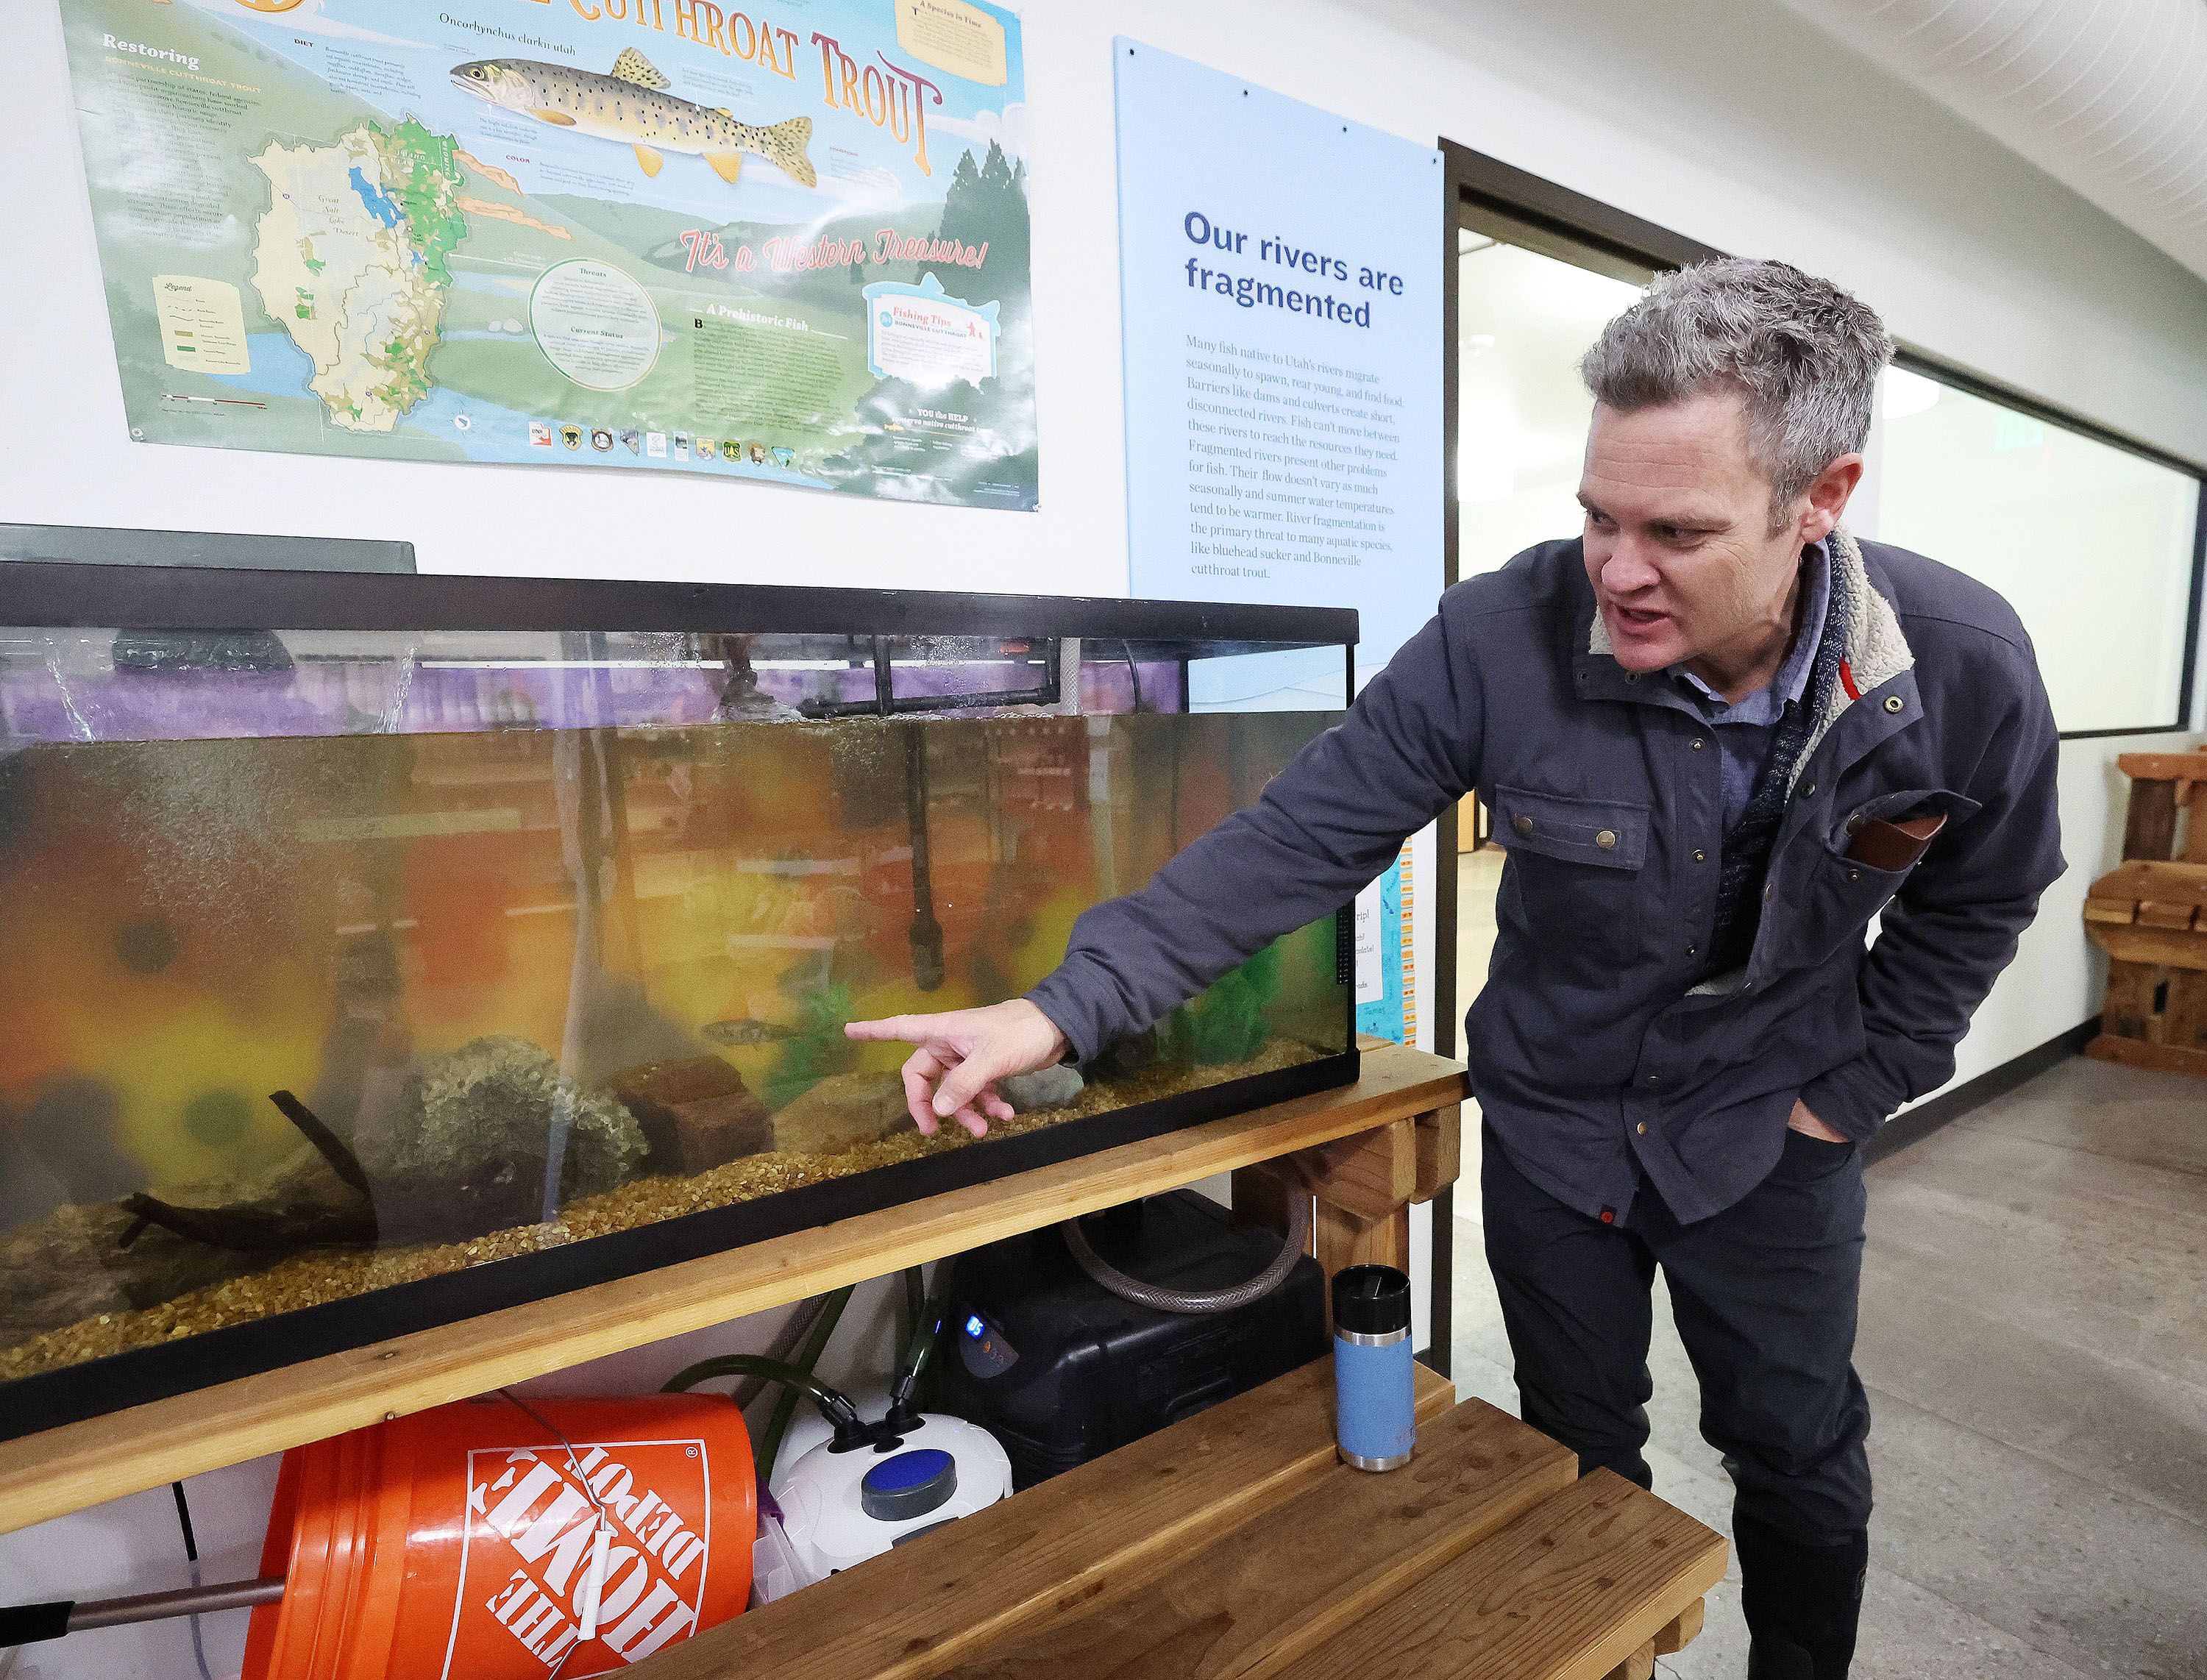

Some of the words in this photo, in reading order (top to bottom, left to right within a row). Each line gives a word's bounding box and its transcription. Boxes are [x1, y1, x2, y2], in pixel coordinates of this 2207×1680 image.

[927, 3, 954, 18] Species
[964, 16, 982, 28] Time
[294, 38, 314, 48] DIET
[439, 12, 515, 40] Oncorhynchus
[553, 44, 575, 56] utah
[102, 33, 200, 71] Restoring
[168, 70, 227, 87] CUTTHROAT
[230, 82, 262, 94] TROUT
[811, 31, 943, 177] TROUT
[505, 154, 531, 164] COLOR
[680, 229, 730, 273] It's
[735, 245, 756, 271] a
[762, 234, 867, 273] Western
[873, 228, 989, 271] Treasure!
[1184, 210, 1248, 255] Our
[1259, 235, 1349, 282] rivers
[1359, 266, 1404, 296] are
[164, 282, 193, 293] Legend
[579, 267, 607, 277] Threats
[1185, 257, 1371, 330] fragmented
[570, 327, 599, 336] Current
[706, 303, 717, 316] A
[718, 305, 784, 327] Prehistoric
[785, 317, 809, 332] Fish
[893, 306, 929, 326] Fishing
[931, 313, 951, 328] Tips
[895, 321, 931, 332] BONNEVILLE
[1187, 335, 1216, 353] Many
[1219, 341, 1237, 355] fish
[1240, 349, 1270, 360] native
[1273, 354, 1282, 364] to
[1285, 355, 1315, 370] Utah's
[1318, 364, 1343, 376] rivers
[1346, 370, 1379, 383] migrate
[1186, 360, 1240, 378] seasonally
[1243, 368, 1252, 378] to
[1255, 373, 1289, 387] spawn,
[1292, 379, 1310, 389] rear
[1314, 383, 1343, 397] young,
[1346, 388, 1362, 399] and
[1365, 390, 1381, 402] find
[1384, 394, 1403, 407] food.
[917, 408, 934, 419] YOU
[1187, 376, 1229, 394] Barriers
[1232, 383, 1250, 398] like
[1253, 388, 1279, 402] dams
[1282, 396, 1300, 407] and
[1302, 399, 1340, 413] culverts
[1341, 408, 1368, 418] create
[1371, 411, 1395, 425] short,
[1187, 398, 1255, 419] disconnected
[1258, 410, 1286, 424] rivers.
[1291, 415, 1311, 428] Fish
[1313, 421, 1335, 432] can't
[1338, 426, 1361, 436] move
[1364, 427, 1399, 442] between
[1188, 419, 1215, 433] these
[1218, 424, 1247, 437] rivers
[1250, 429, 1259, 439] to
[1262, 433, 1289, 444] reach
[1291, 434, 1307, 446] the
[1309, 440, 1352, 452] resources
[1354, 445, 1373, 459] they
[1376, 450, 1398, 460] need.
[1189, 439, 1251, 458] Fragmented
[1254, 449, 1282, 462] rivers
[1284, 455, 1318, 467] present
[1321, 459, 1345, 470] other
[1347, 463, 1387, 476] problems
[1189, 459, 1204, 471] for
[1206, 462, 1227, 475] fish.
[1229, 465, 1258, 479] Their
[1262, 469, 1282, 481] flow
[1284, 472, 1317, 487] doesn't
[1320, 480, 1340, 492] vary
[1354, 484, 1377, 494] much
[1189, 484, 1243, 499] seasonally
[1245, 488, 1263, 499] and
[1266, 493, 1306, 504] summer
[1308, 497, 1334, 507] water
[1336, 499, 1394, 513] temperatures
[1190, 502, 1213, 514] tend
[1216, 505, 1226, 515] to
[1229, 504, 1240, 516] be
[1243, 510, 1283, 521] warmer.
[1286, 511, 1311, 524] River
[1313, 515, 1376, 530] fragmentation
[1190, 521, 1207, 534] the
[1210, 524, 1251, 540] primary
[1254, 527, 1283, 540] threat
[1287, 532, 1296, 541] to
[1298, 535, 1324, 547] many
[1326, 538, 1358, 548] aquatic
[1360, 541, 1393, 552] species,
[1190, 541, 1209, 554] like
[1212, 543, 1257, 558] bluehead
[1259, 548, 1291, 560] sucker
[1293, 551, 1310, 562] and
[1313, 552, 1361, 565] Bonneville
[1191, 563, 1239, 576] cutthroat
[1243, 567, 1270, 577] trout.
[564, 1446, 705, 1581] DEPOT
[471, 1450, 697, 1664] HOME
[485, 1568, 581, 1668] THE
